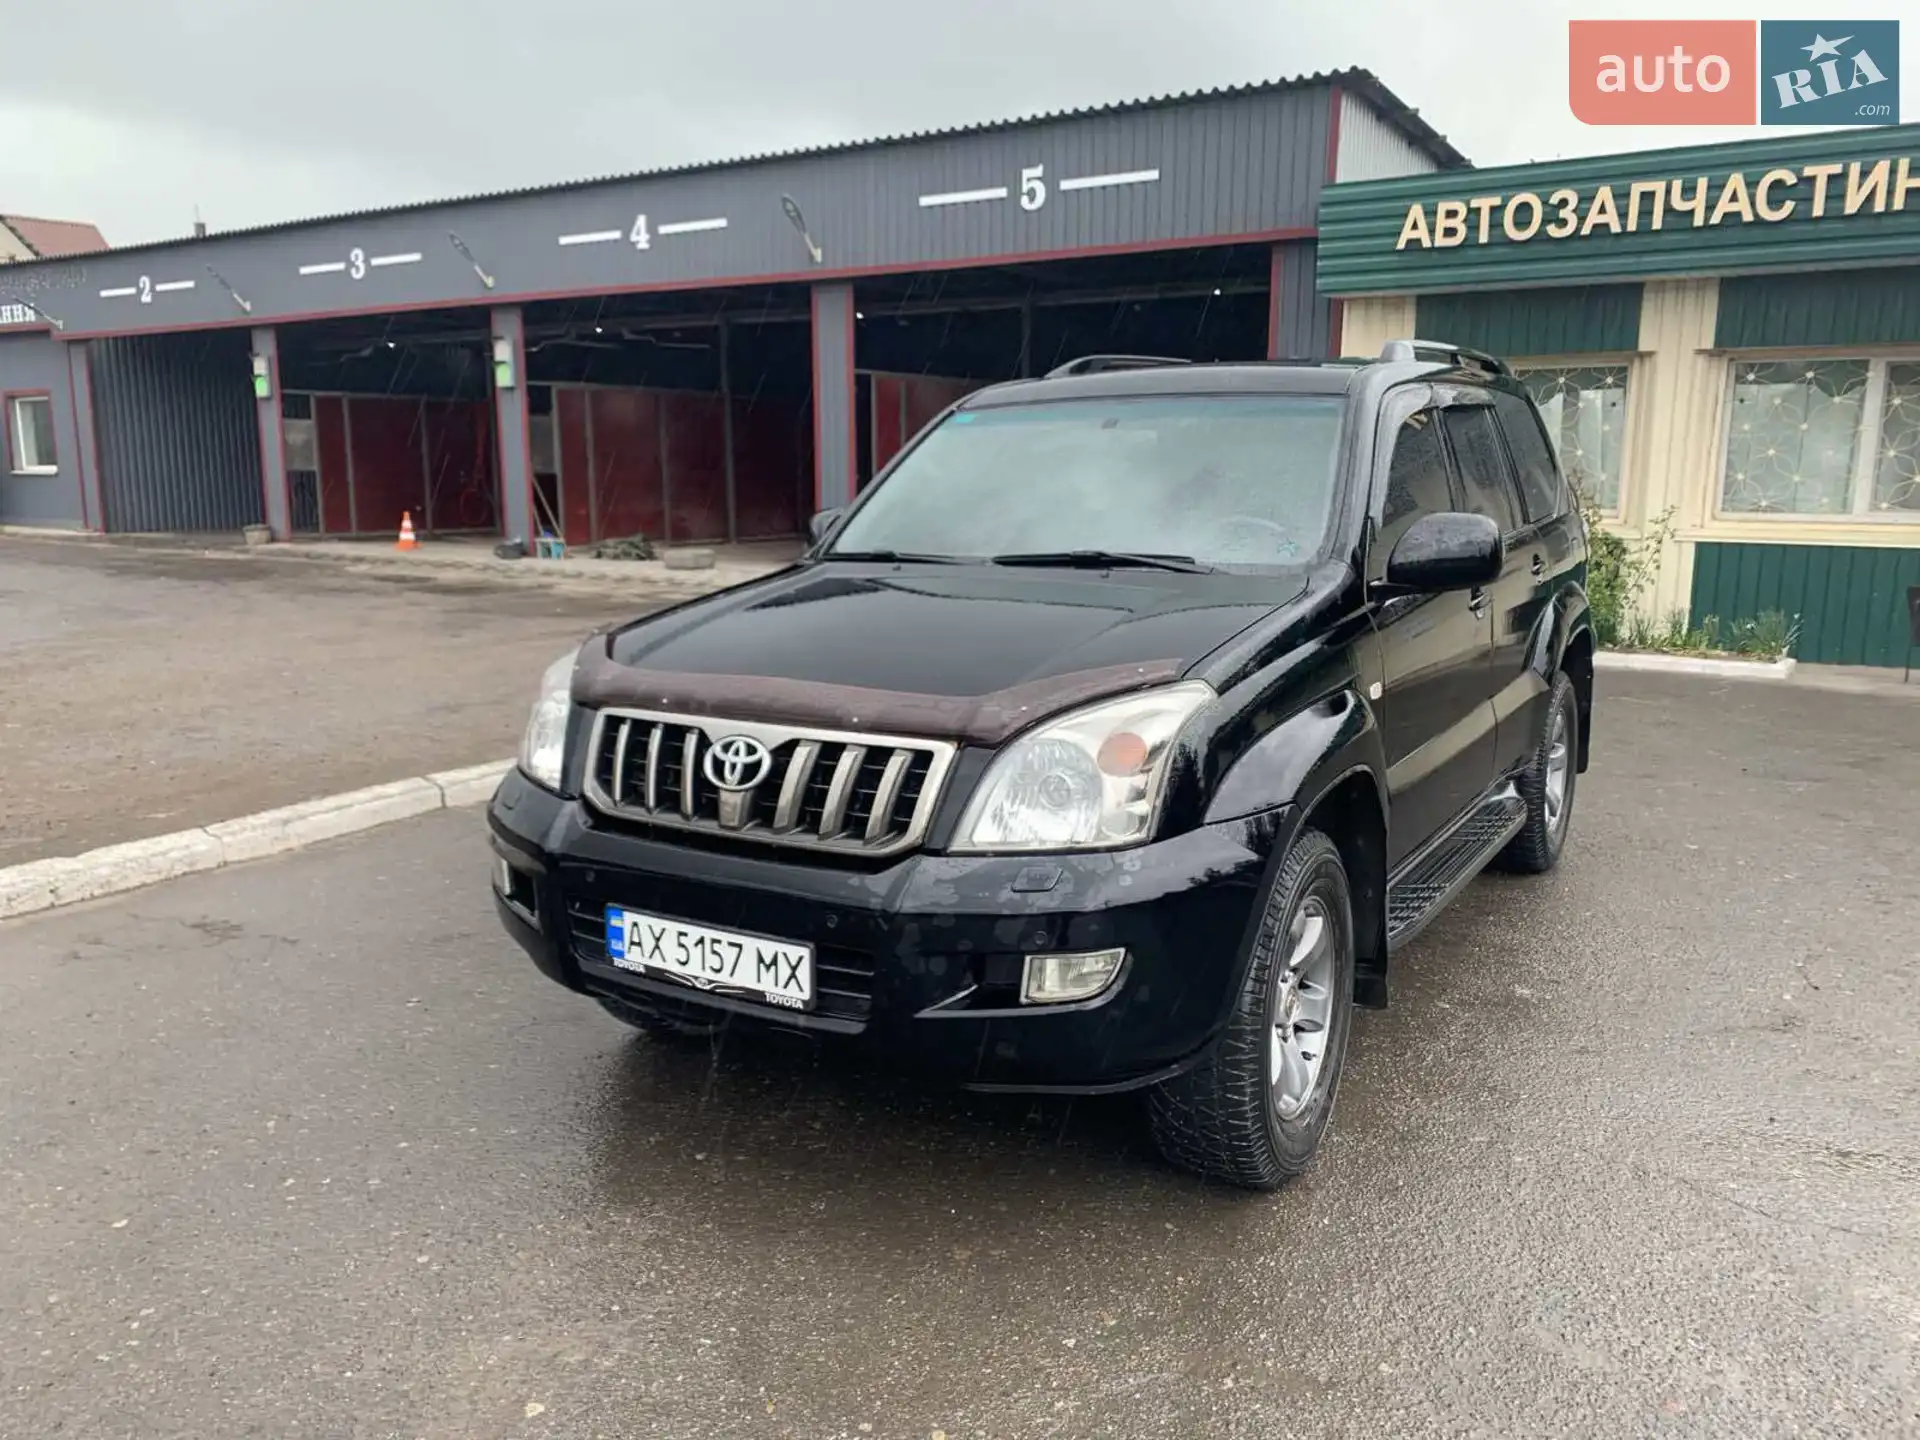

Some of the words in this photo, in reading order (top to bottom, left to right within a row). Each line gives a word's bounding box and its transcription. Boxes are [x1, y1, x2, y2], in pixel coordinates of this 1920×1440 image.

[1020, 163, 1046, 211] 5
[629, 214, 650, 250] 4
[350, 248, 366, 279] 3
[139, 275, 152, 303] 2
[676, 932, 743, 978] 5157
[764, 992, 804, 1009] TOYOTA
